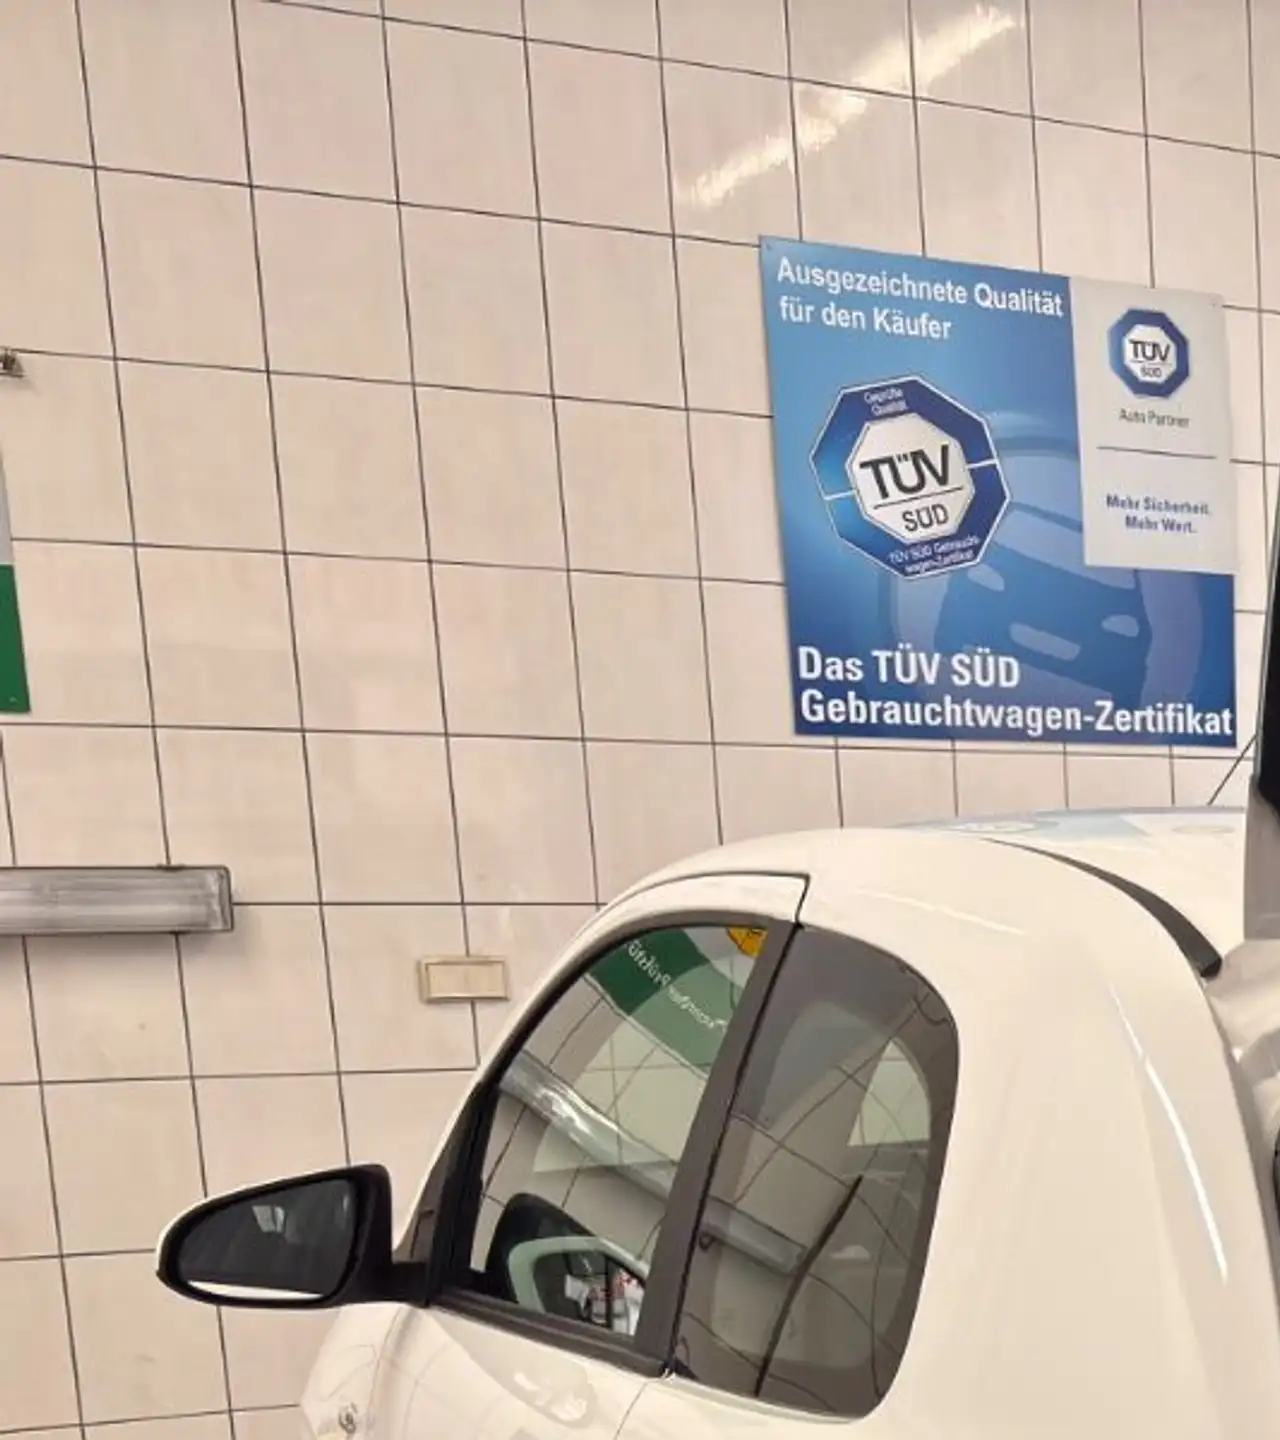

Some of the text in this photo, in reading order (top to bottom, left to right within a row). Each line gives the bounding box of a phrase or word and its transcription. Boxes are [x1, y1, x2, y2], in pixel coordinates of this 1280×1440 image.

[777, 256, 1064, 318] Ausgezeichnete Qualität
[779, 296, 952, 341] für den Käufer
[1128, 339, 1171, 361] TÜV
[859, 443, 950, 499] TÜV
[902, 504, 949, 532] SÜD
[1106, 493, 1140, 510] Mehr
[1125, 514, 1198, 534] Mehr Wert.
[797, 643, 1021, 688] Das TÜV SÜD
[801, 688, 1234, 737] Gebrauchtwagen-Zertifikat
